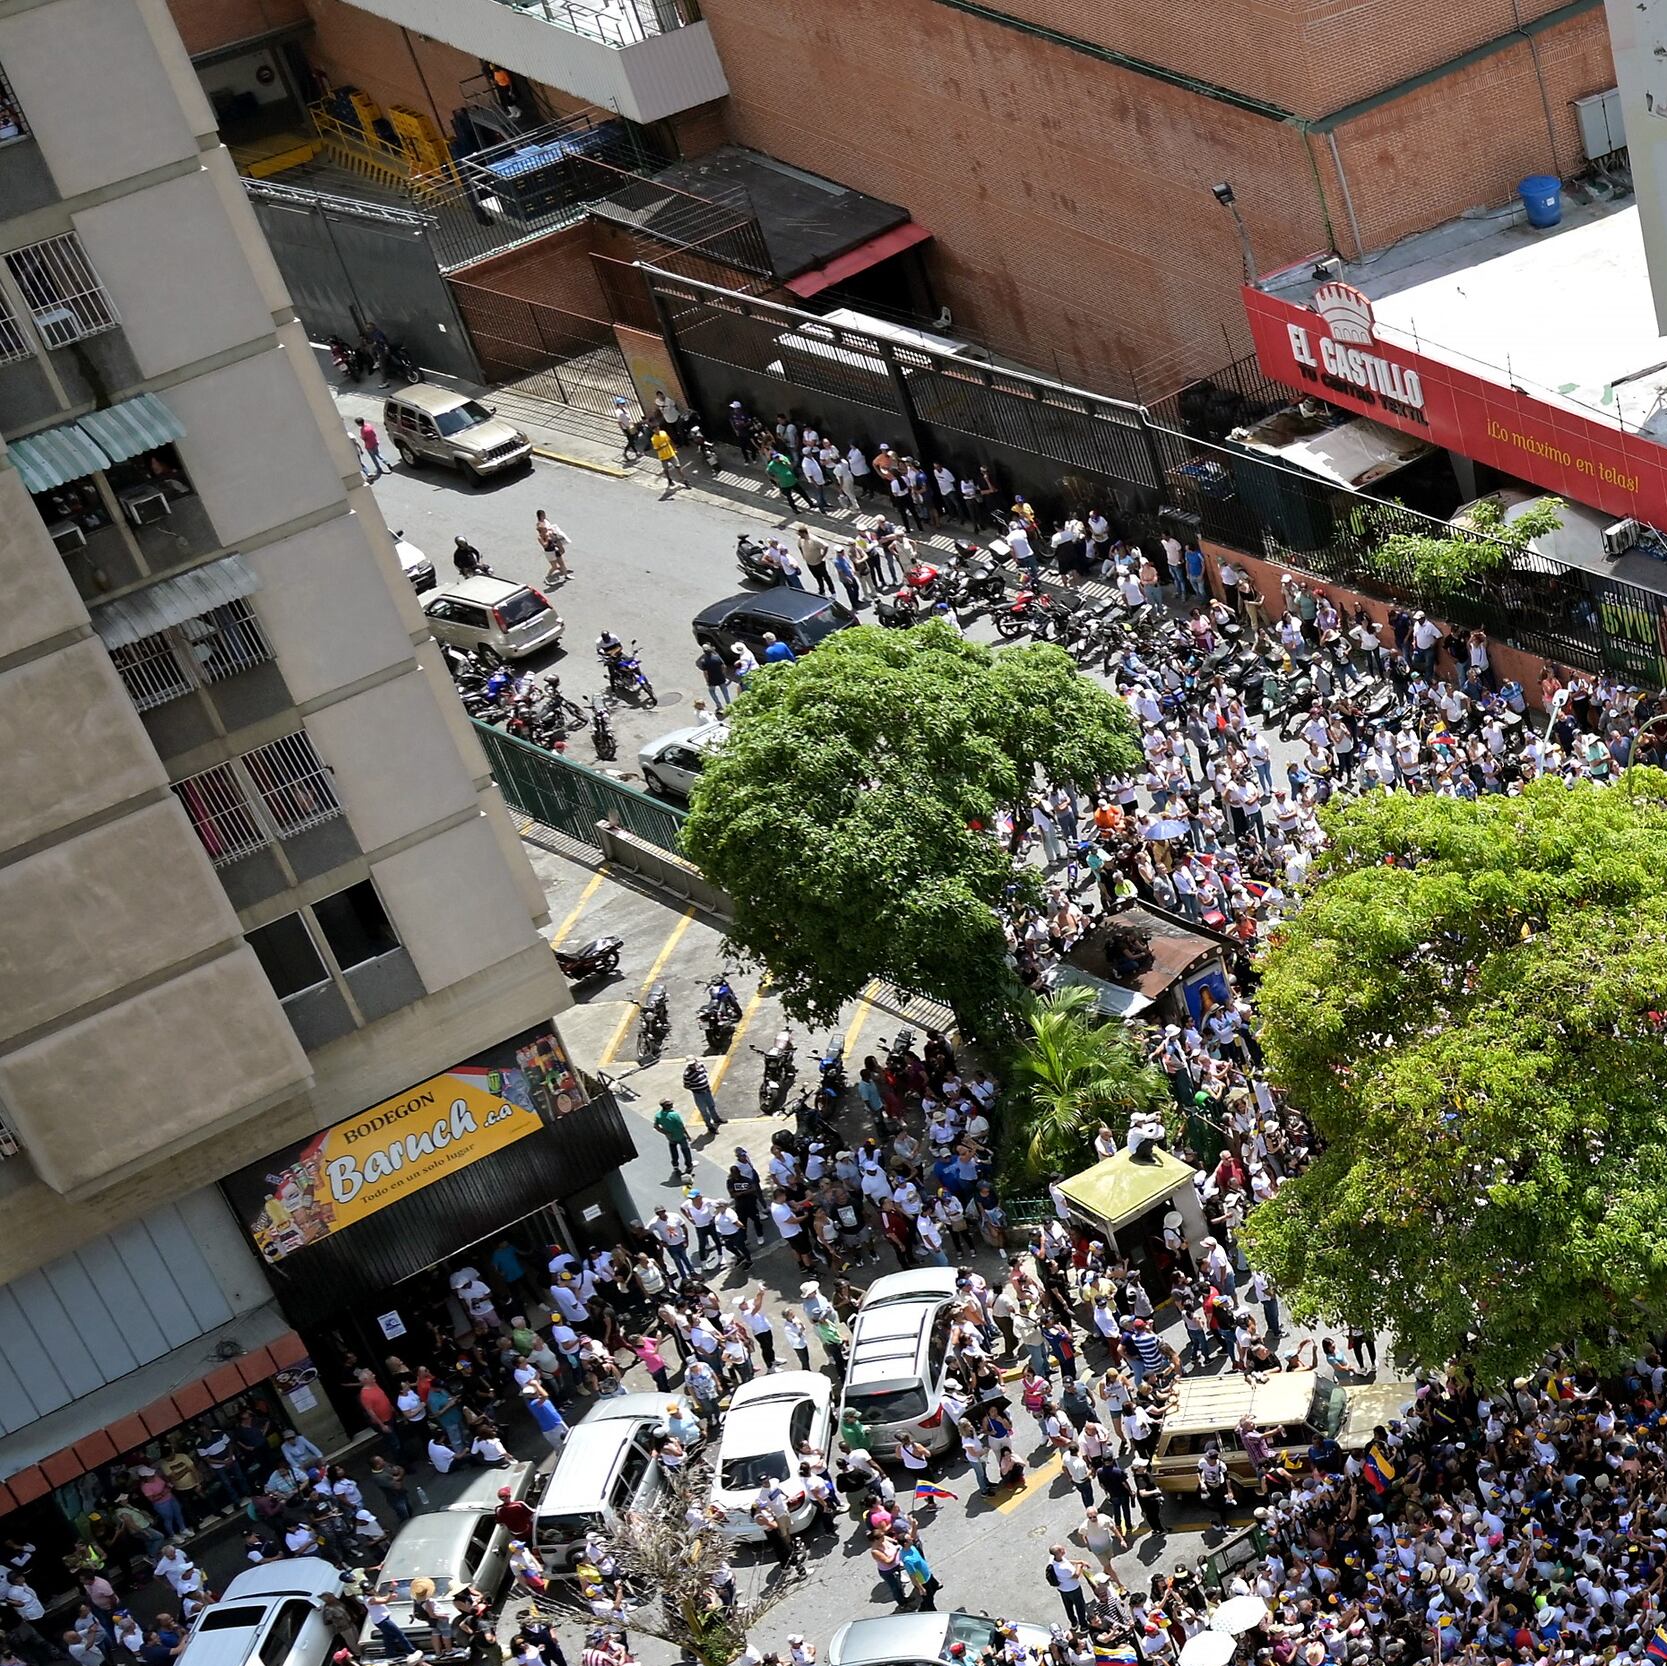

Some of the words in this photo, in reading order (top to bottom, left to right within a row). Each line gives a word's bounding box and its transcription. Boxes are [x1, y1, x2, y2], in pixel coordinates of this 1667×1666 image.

[1287, 323, 1318, 368] EL
[1319, 336, 1425, 409] CASTILLO
[1378, 395, 1429, 425] TEXTIL
[1512, 431, 1571, 466] máximo
[1576, 458, 1595, 476] en
[1599, 462, 1639, 493] telas!
[343, 1091, 435, 1145] BODEGON
[325, 1098, 478, 1204] Baruch
[360, 1185, 389, 1205] Todo
[390, 1179, 405, 1190] en
[406, 1169, 422, 1181] un
[423, 1157, 445, 1176] solo
[445, 1143, 475, 1163] lugar
